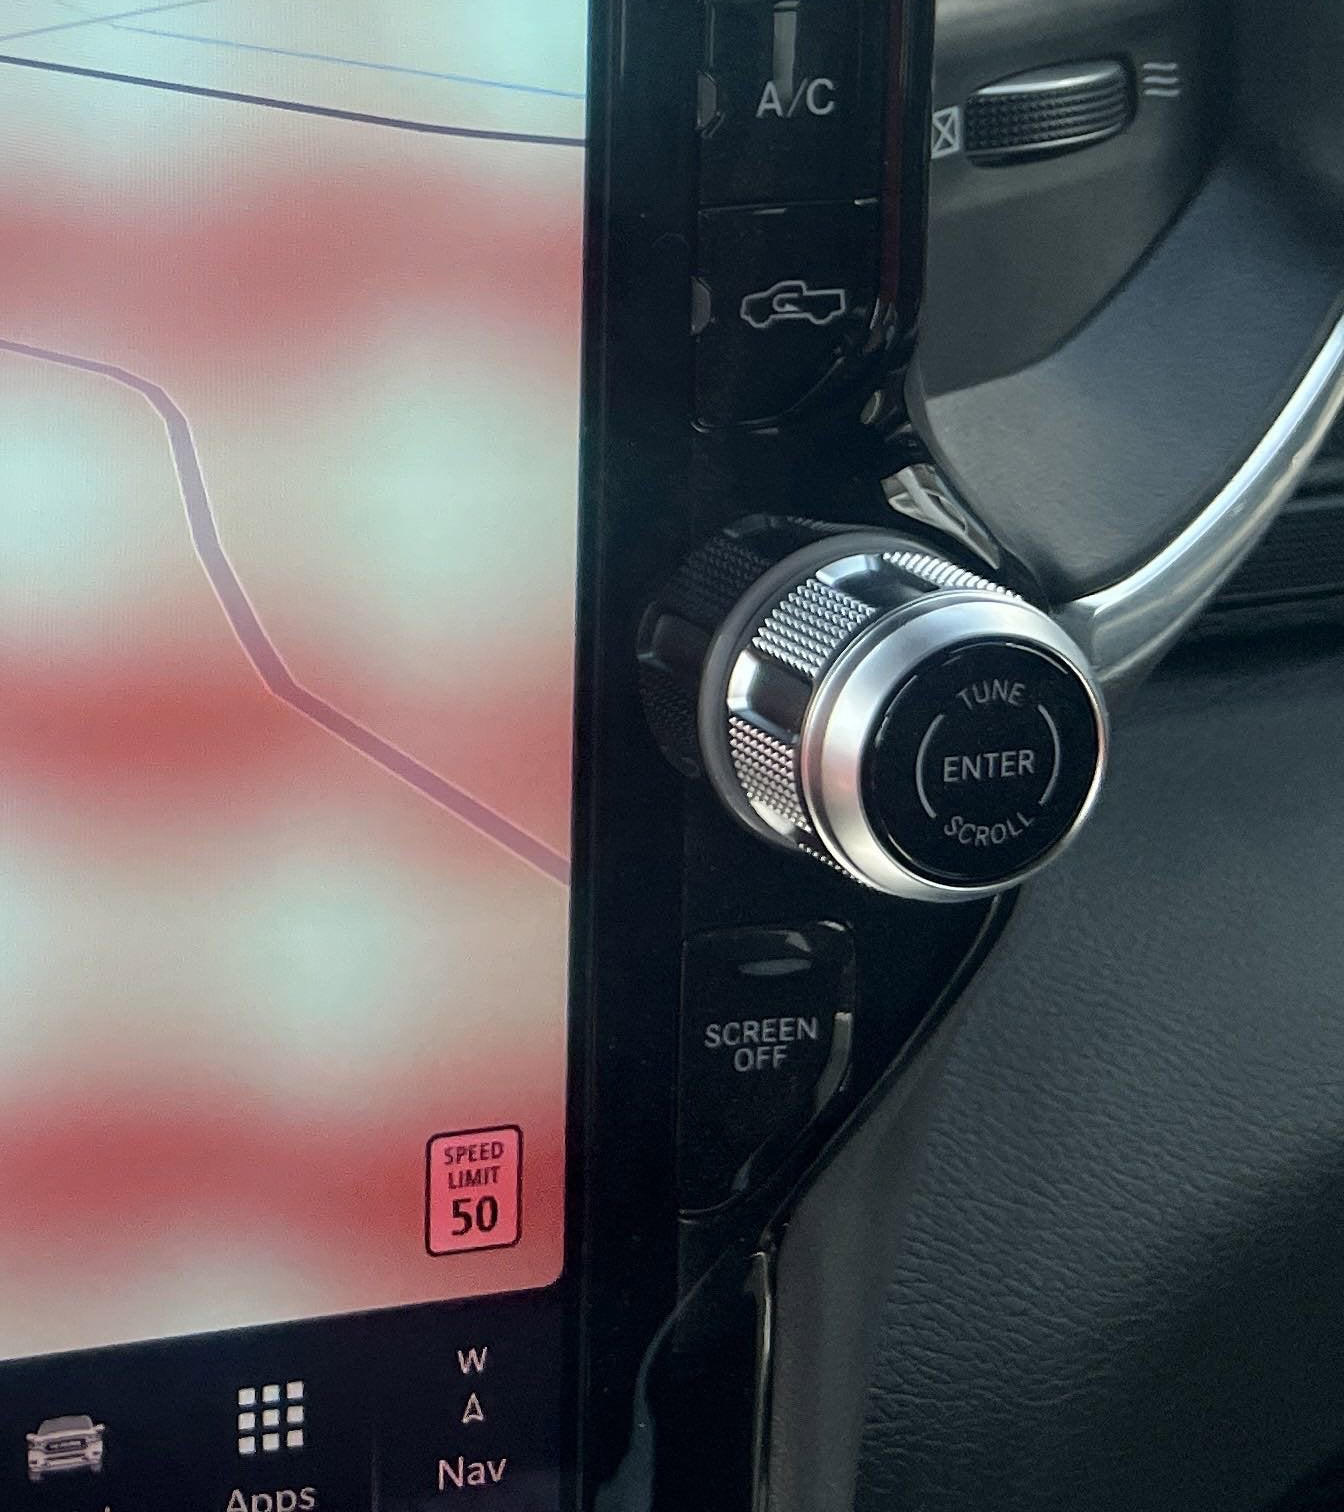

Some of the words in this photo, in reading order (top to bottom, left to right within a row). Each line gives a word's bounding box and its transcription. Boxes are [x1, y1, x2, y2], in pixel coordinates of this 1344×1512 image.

[757, 78, 835, 118] A/C
[957, 680, 1026, 712] TUNE
[944, 749, 1035, 783] ENTER
[944, 812, 1035, 847] SCROLL
[705, 1017, 818, 1049] SCREEN
[734, 1047, 788, 1073] OFF
[443, 1142, 504, 1165] SPEED
[448, 1166, 500, 1190] LIMIT
[451, 1196, 498, 1237] 50
[457, 1346, 488, 1374] W
[438, 1456, 507, 1490] Nav
[226, 1484, 316, 1512] Apps
